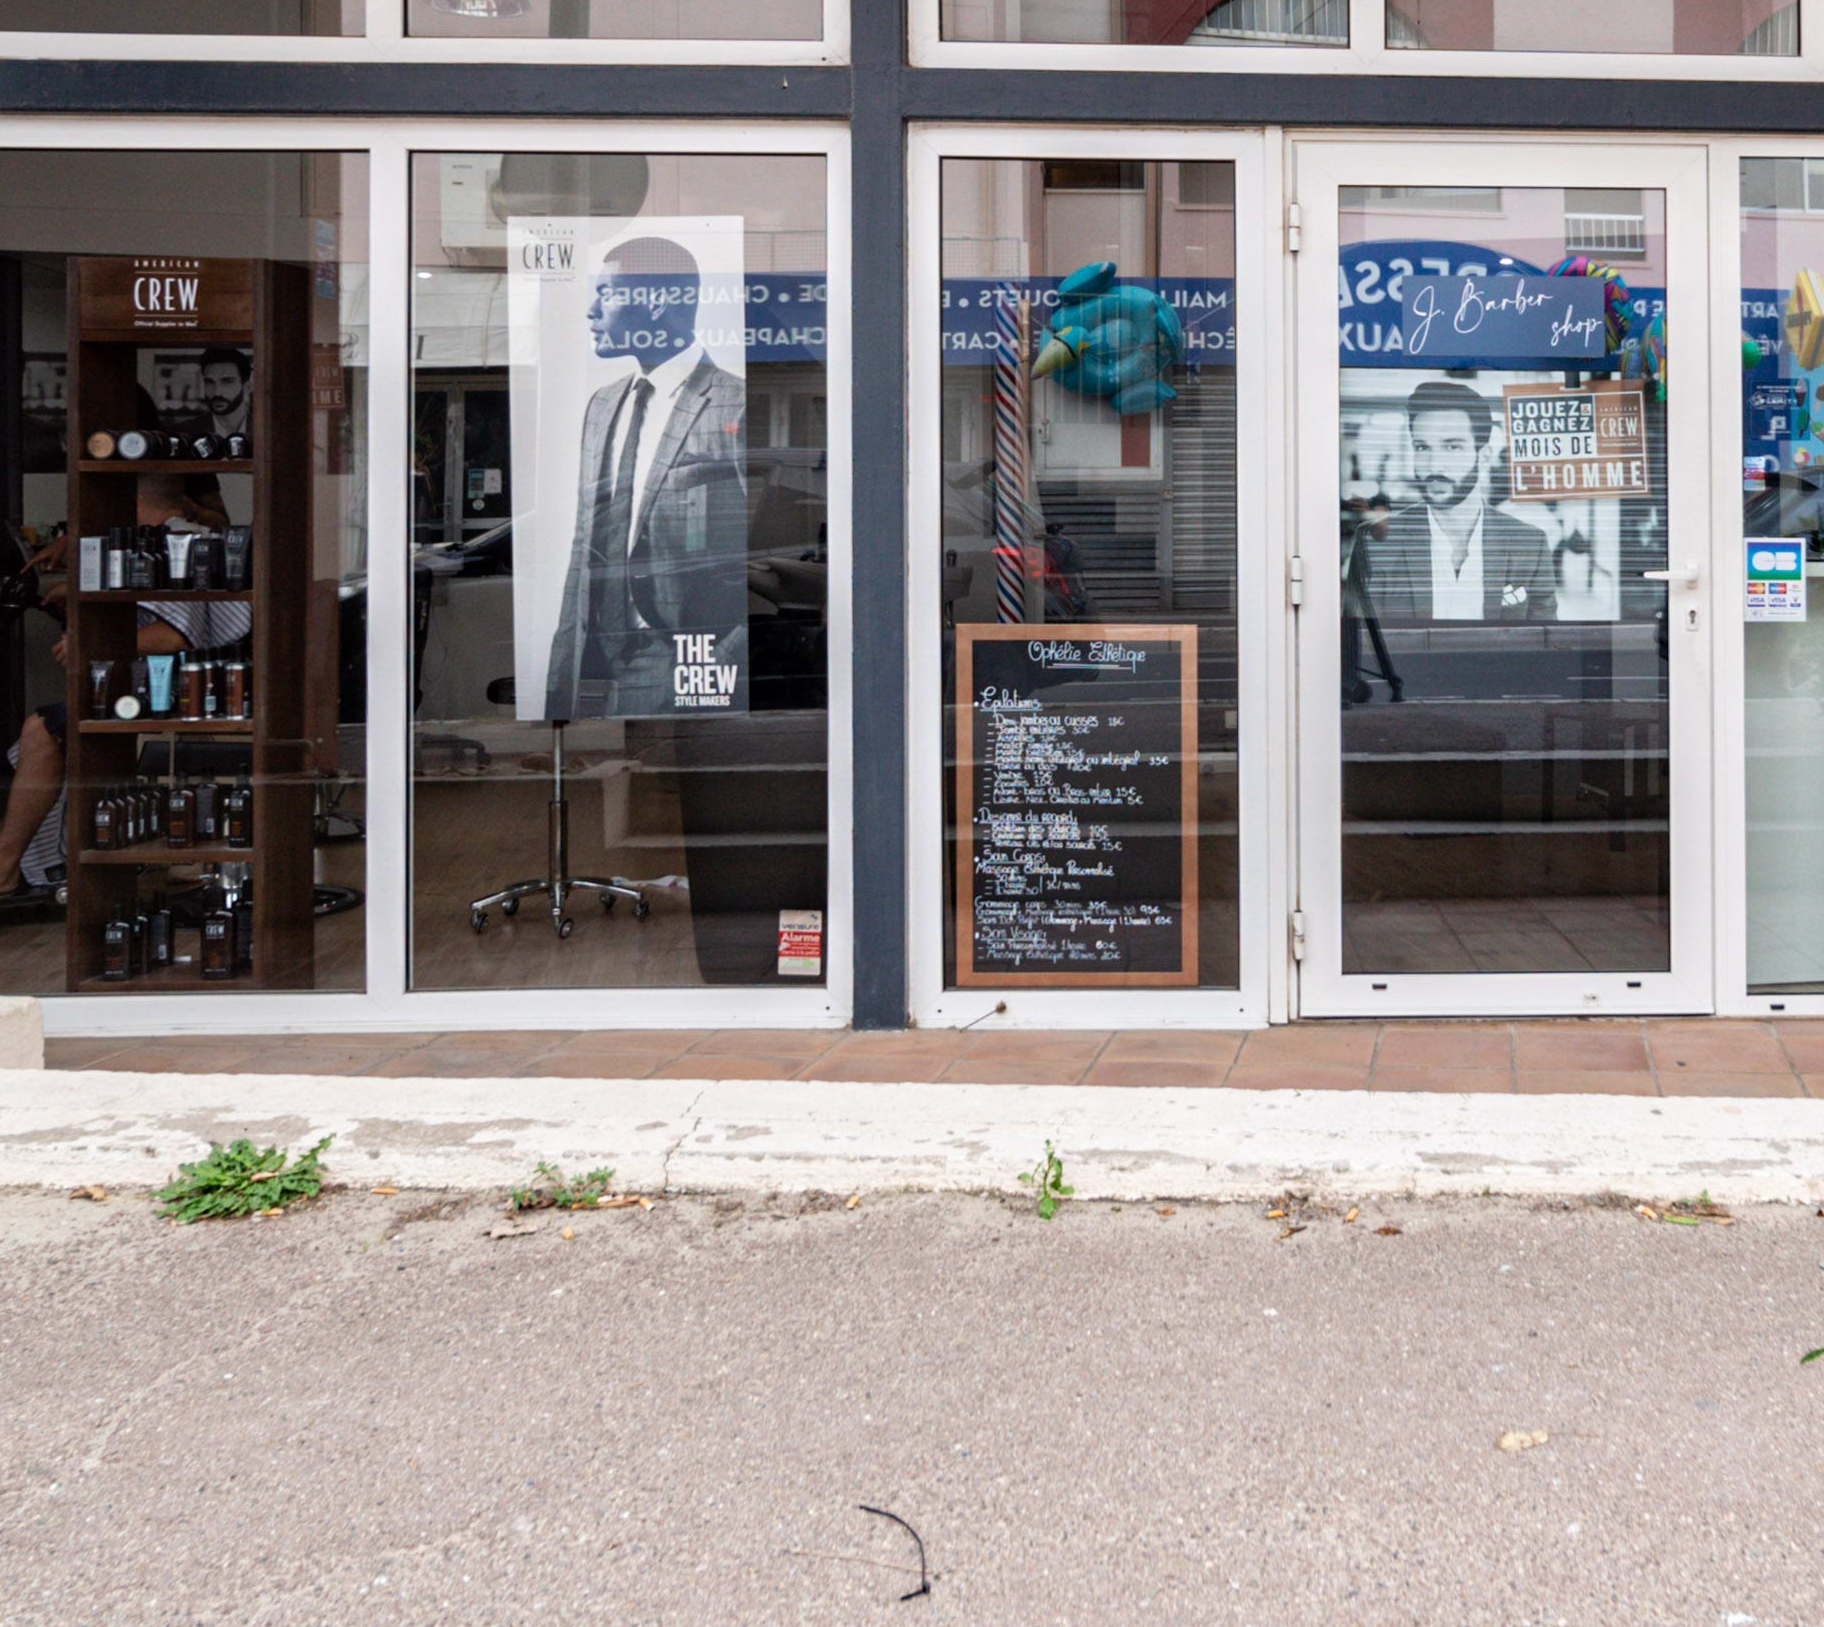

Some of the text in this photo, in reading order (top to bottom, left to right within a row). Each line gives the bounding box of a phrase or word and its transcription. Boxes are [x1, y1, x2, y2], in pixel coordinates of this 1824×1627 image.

[522, 243, 575, 270] CREW
[133, 276, 199, 311] CREW
[1453, 277, 1555, 335] Barber
[1549, 303, 1603, 348] shop
[1512, 400, 1579, 419] JOUEZ
[1512, 416, 1590, 434] GAGNEZ
[1600, 416, 1638, 438] CREW
[1514, 435, 1592, 458] MOIS DE
[1515, 460, 1643, 491] L'HOMME
[673, 634, 716, 664] THE
[1028, 640, 1082, 669] Ophélie
[674, 664, 738, 695] CREW
[674, 695, 731, 707] STYLE MAKERS
